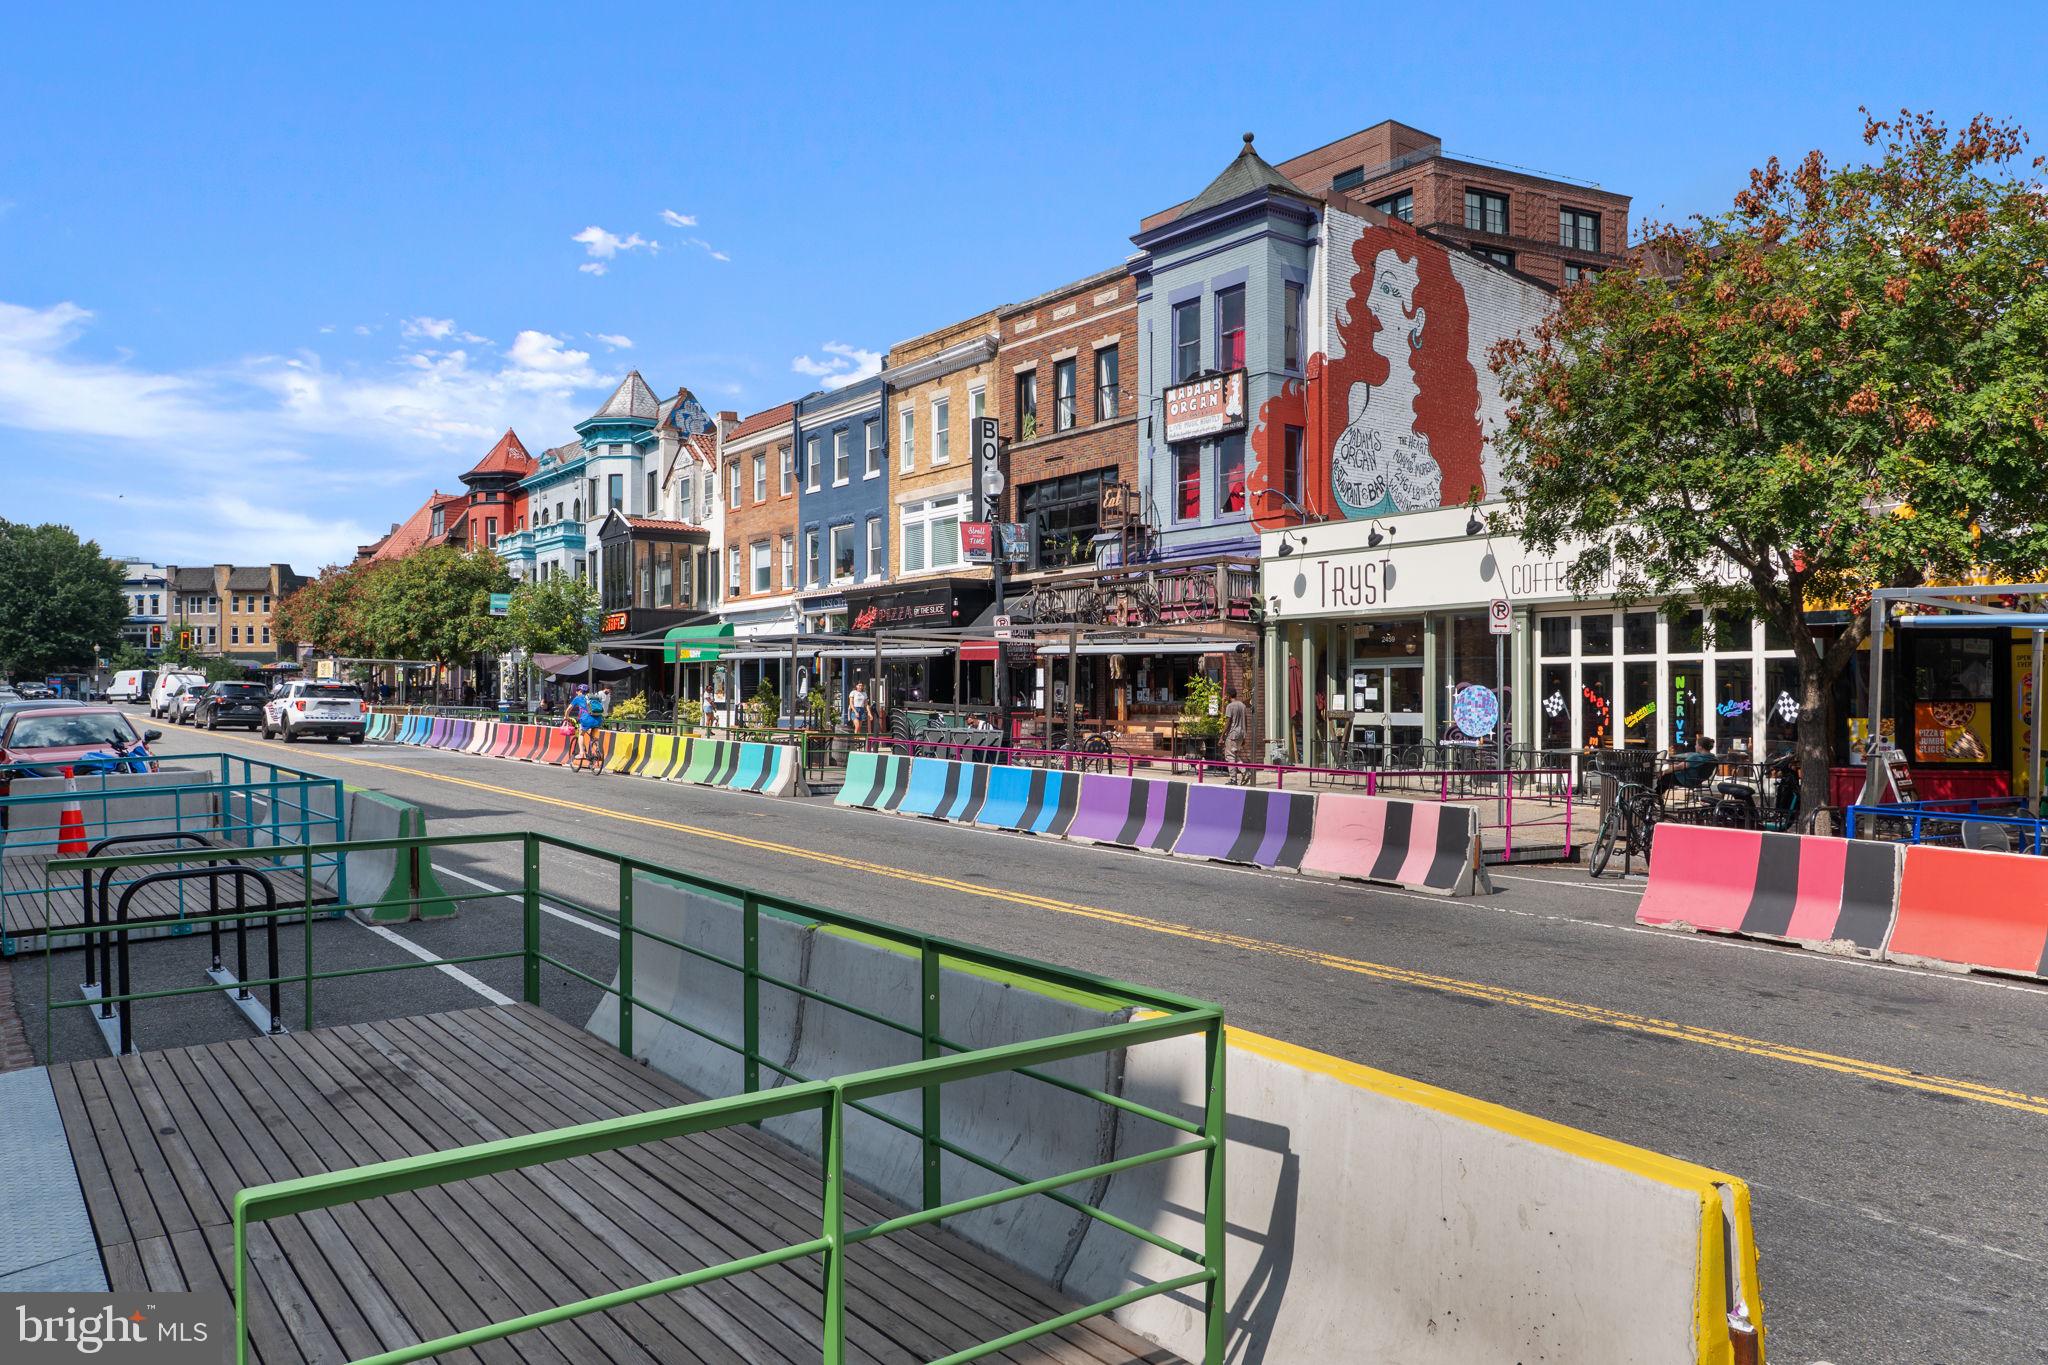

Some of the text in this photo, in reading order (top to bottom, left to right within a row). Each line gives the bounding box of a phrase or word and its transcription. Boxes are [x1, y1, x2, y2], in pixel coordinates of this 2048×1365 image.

[1170, 394, 1217, 415] ORGAN
[1341, 443, 1377, 471] ORGAN
[1368, 475, 1385, 501] BAR
[1103, 489, 1120, 508] Eat
[968, 527, 985, 535] Stroll
[969, 537, 985, 545] TIME
[879, 606, 912, 622] PIZZA
[1675, 676, 1686, 744] NERVE
[1717, 699, 1752, 715] talent
[1919, 729, 1938, 737] PIZZA
[1919, 737, 1945, 745] JUMBO
[1919, 745, 1945, 753] SLICES
